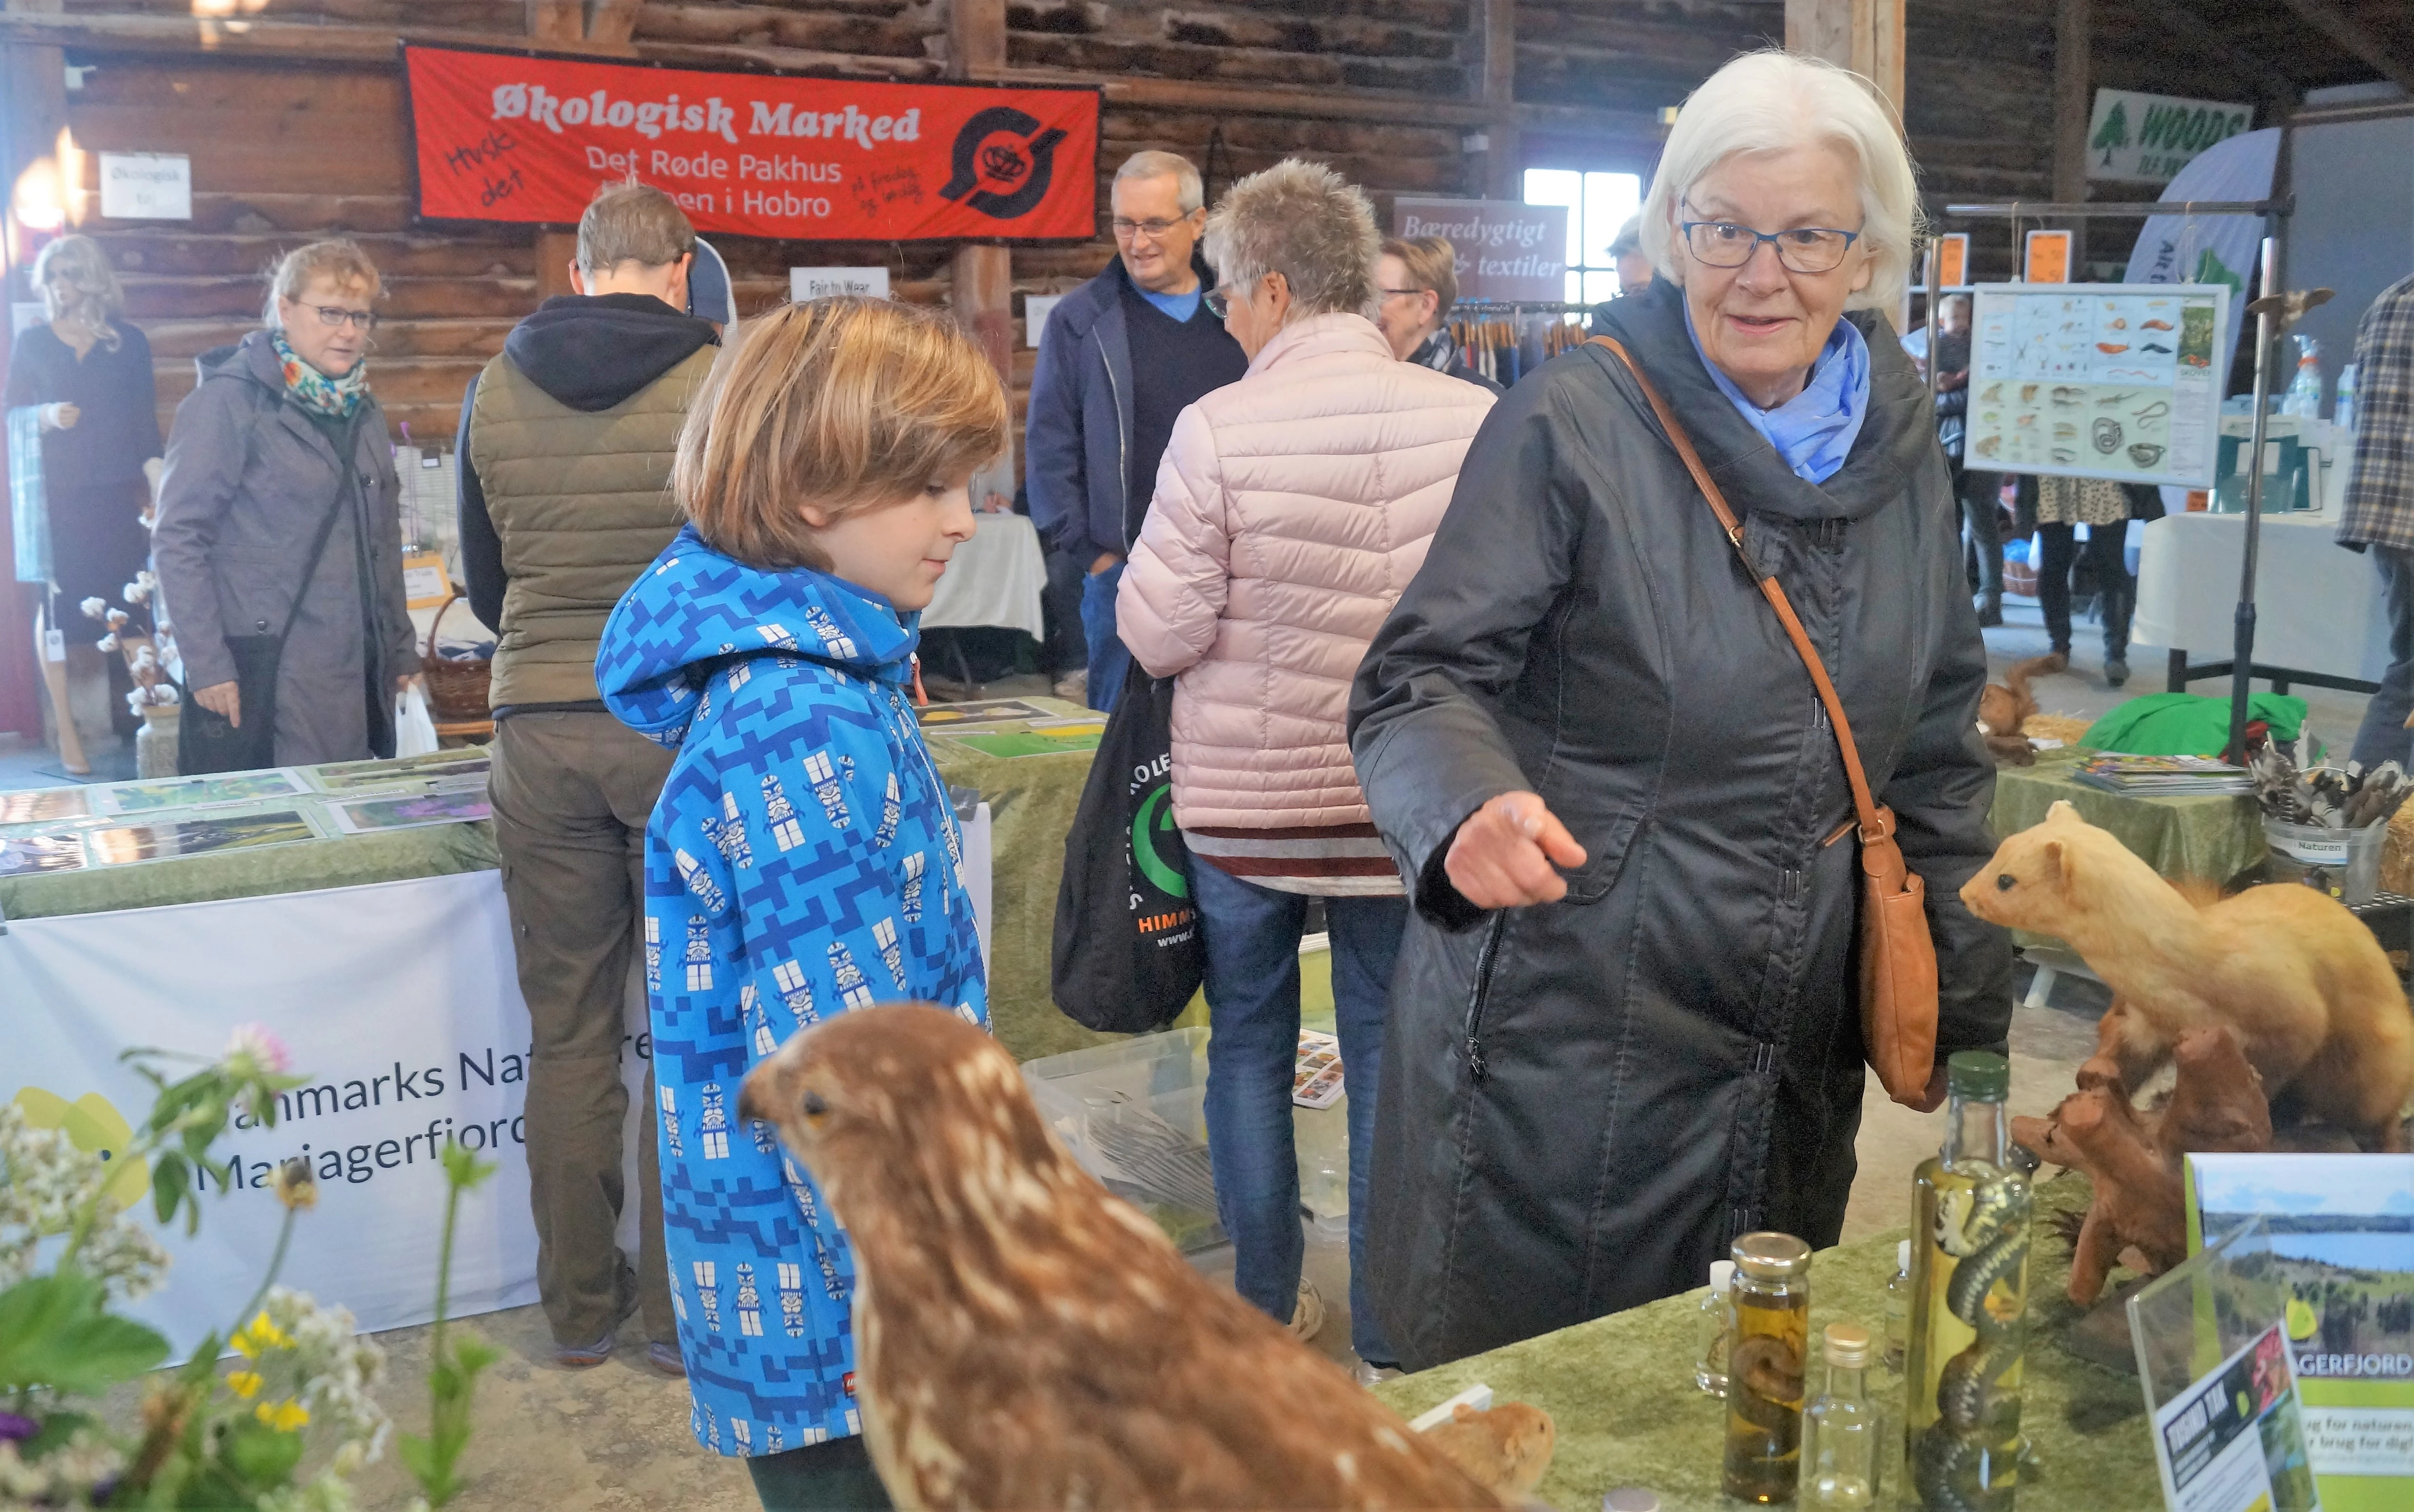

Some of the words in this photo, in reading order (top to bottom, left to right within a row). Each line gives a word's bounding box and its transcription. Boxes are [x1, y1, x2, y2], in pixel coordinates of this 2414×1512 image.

[491, 83, 738, 143] Økologisk
[748, 101, 921, 150] Marked
[585, 146, 639, 174] Det
[651, 151, 729, 179] Røde
[739, 154, 842, 183] Pakhus
[481, 168, 525, 207] det
[725, 187, 733, 213] i
[743, 190, 831, 217] Hobro
[1403, 216, 1546, 246] Bæredygtigt
[1477, 254, 1562, 277] textiler
[809, 279, 829, 295] Fair
[844, 279, 870, 293] Wear
[2299, 842, 2341, 852] Naturen
[234, 1062, 445, 1130] anmarks
